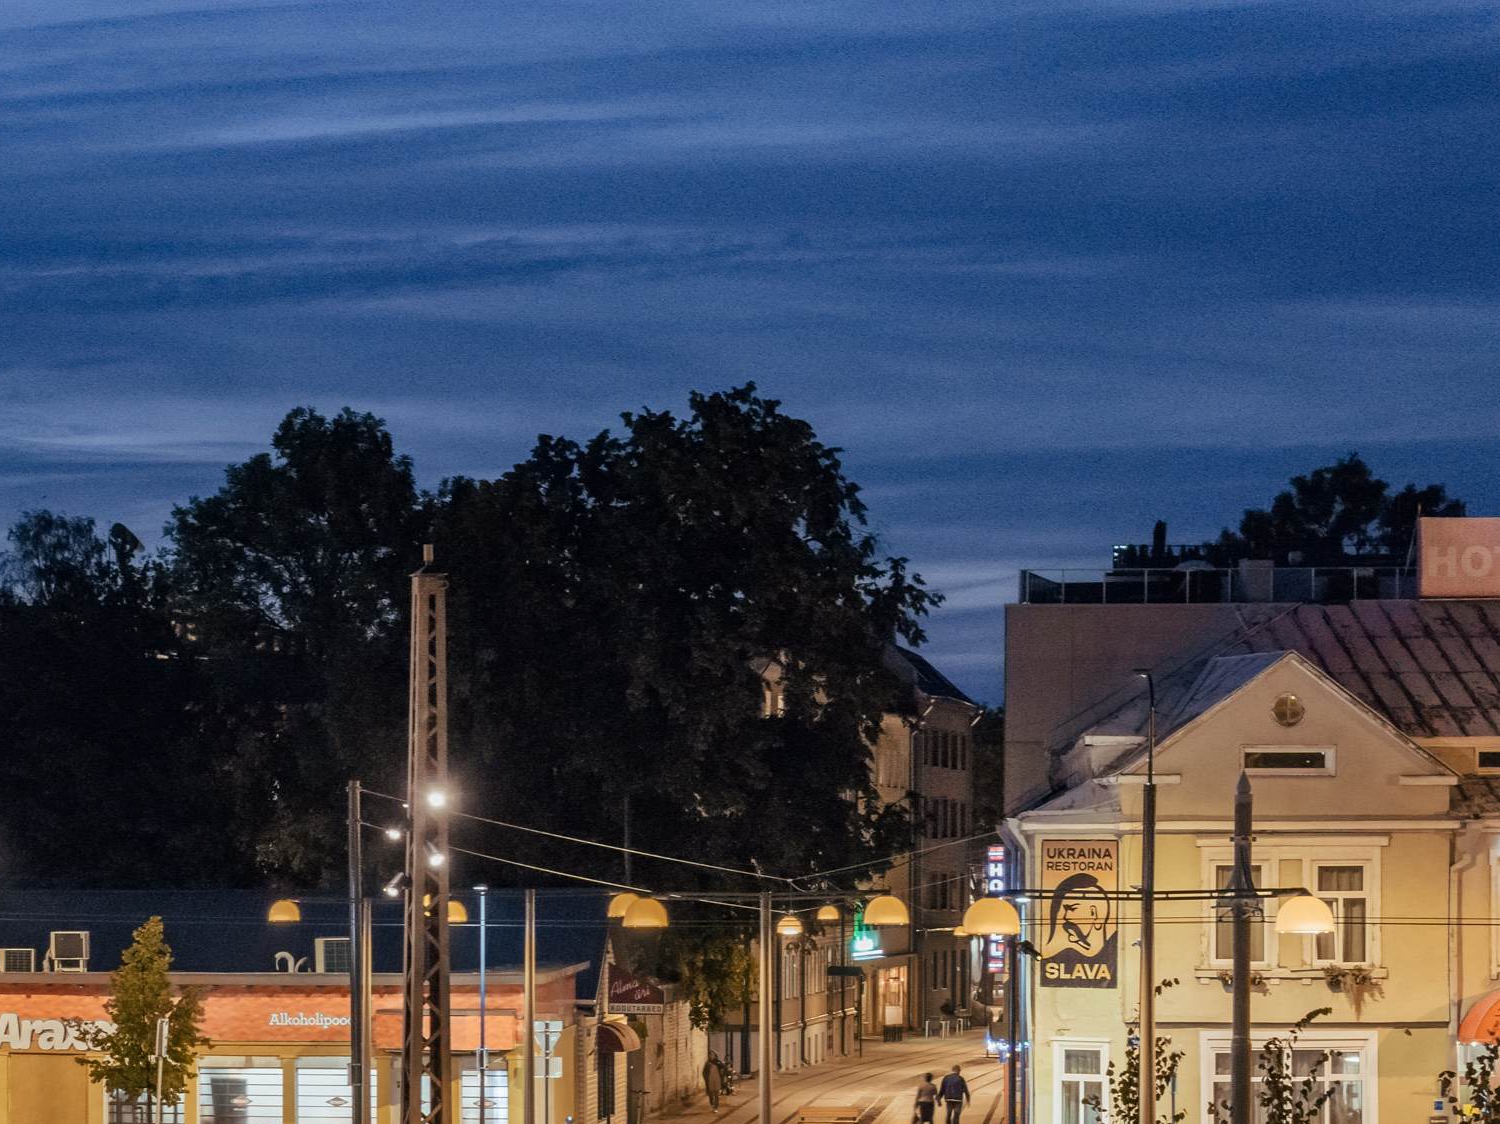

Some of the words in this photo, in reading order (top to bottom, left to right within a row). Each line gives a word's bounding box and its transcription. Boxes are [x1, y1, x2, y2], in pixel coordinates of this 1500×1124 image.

[1427, 545, 1499, 577] HO
[1047, 848, 1113, 859] UKRAINA
[1046, 861, 1113, 871] RESTORAN
[1045, 962, 1111, 980] SLAVA
